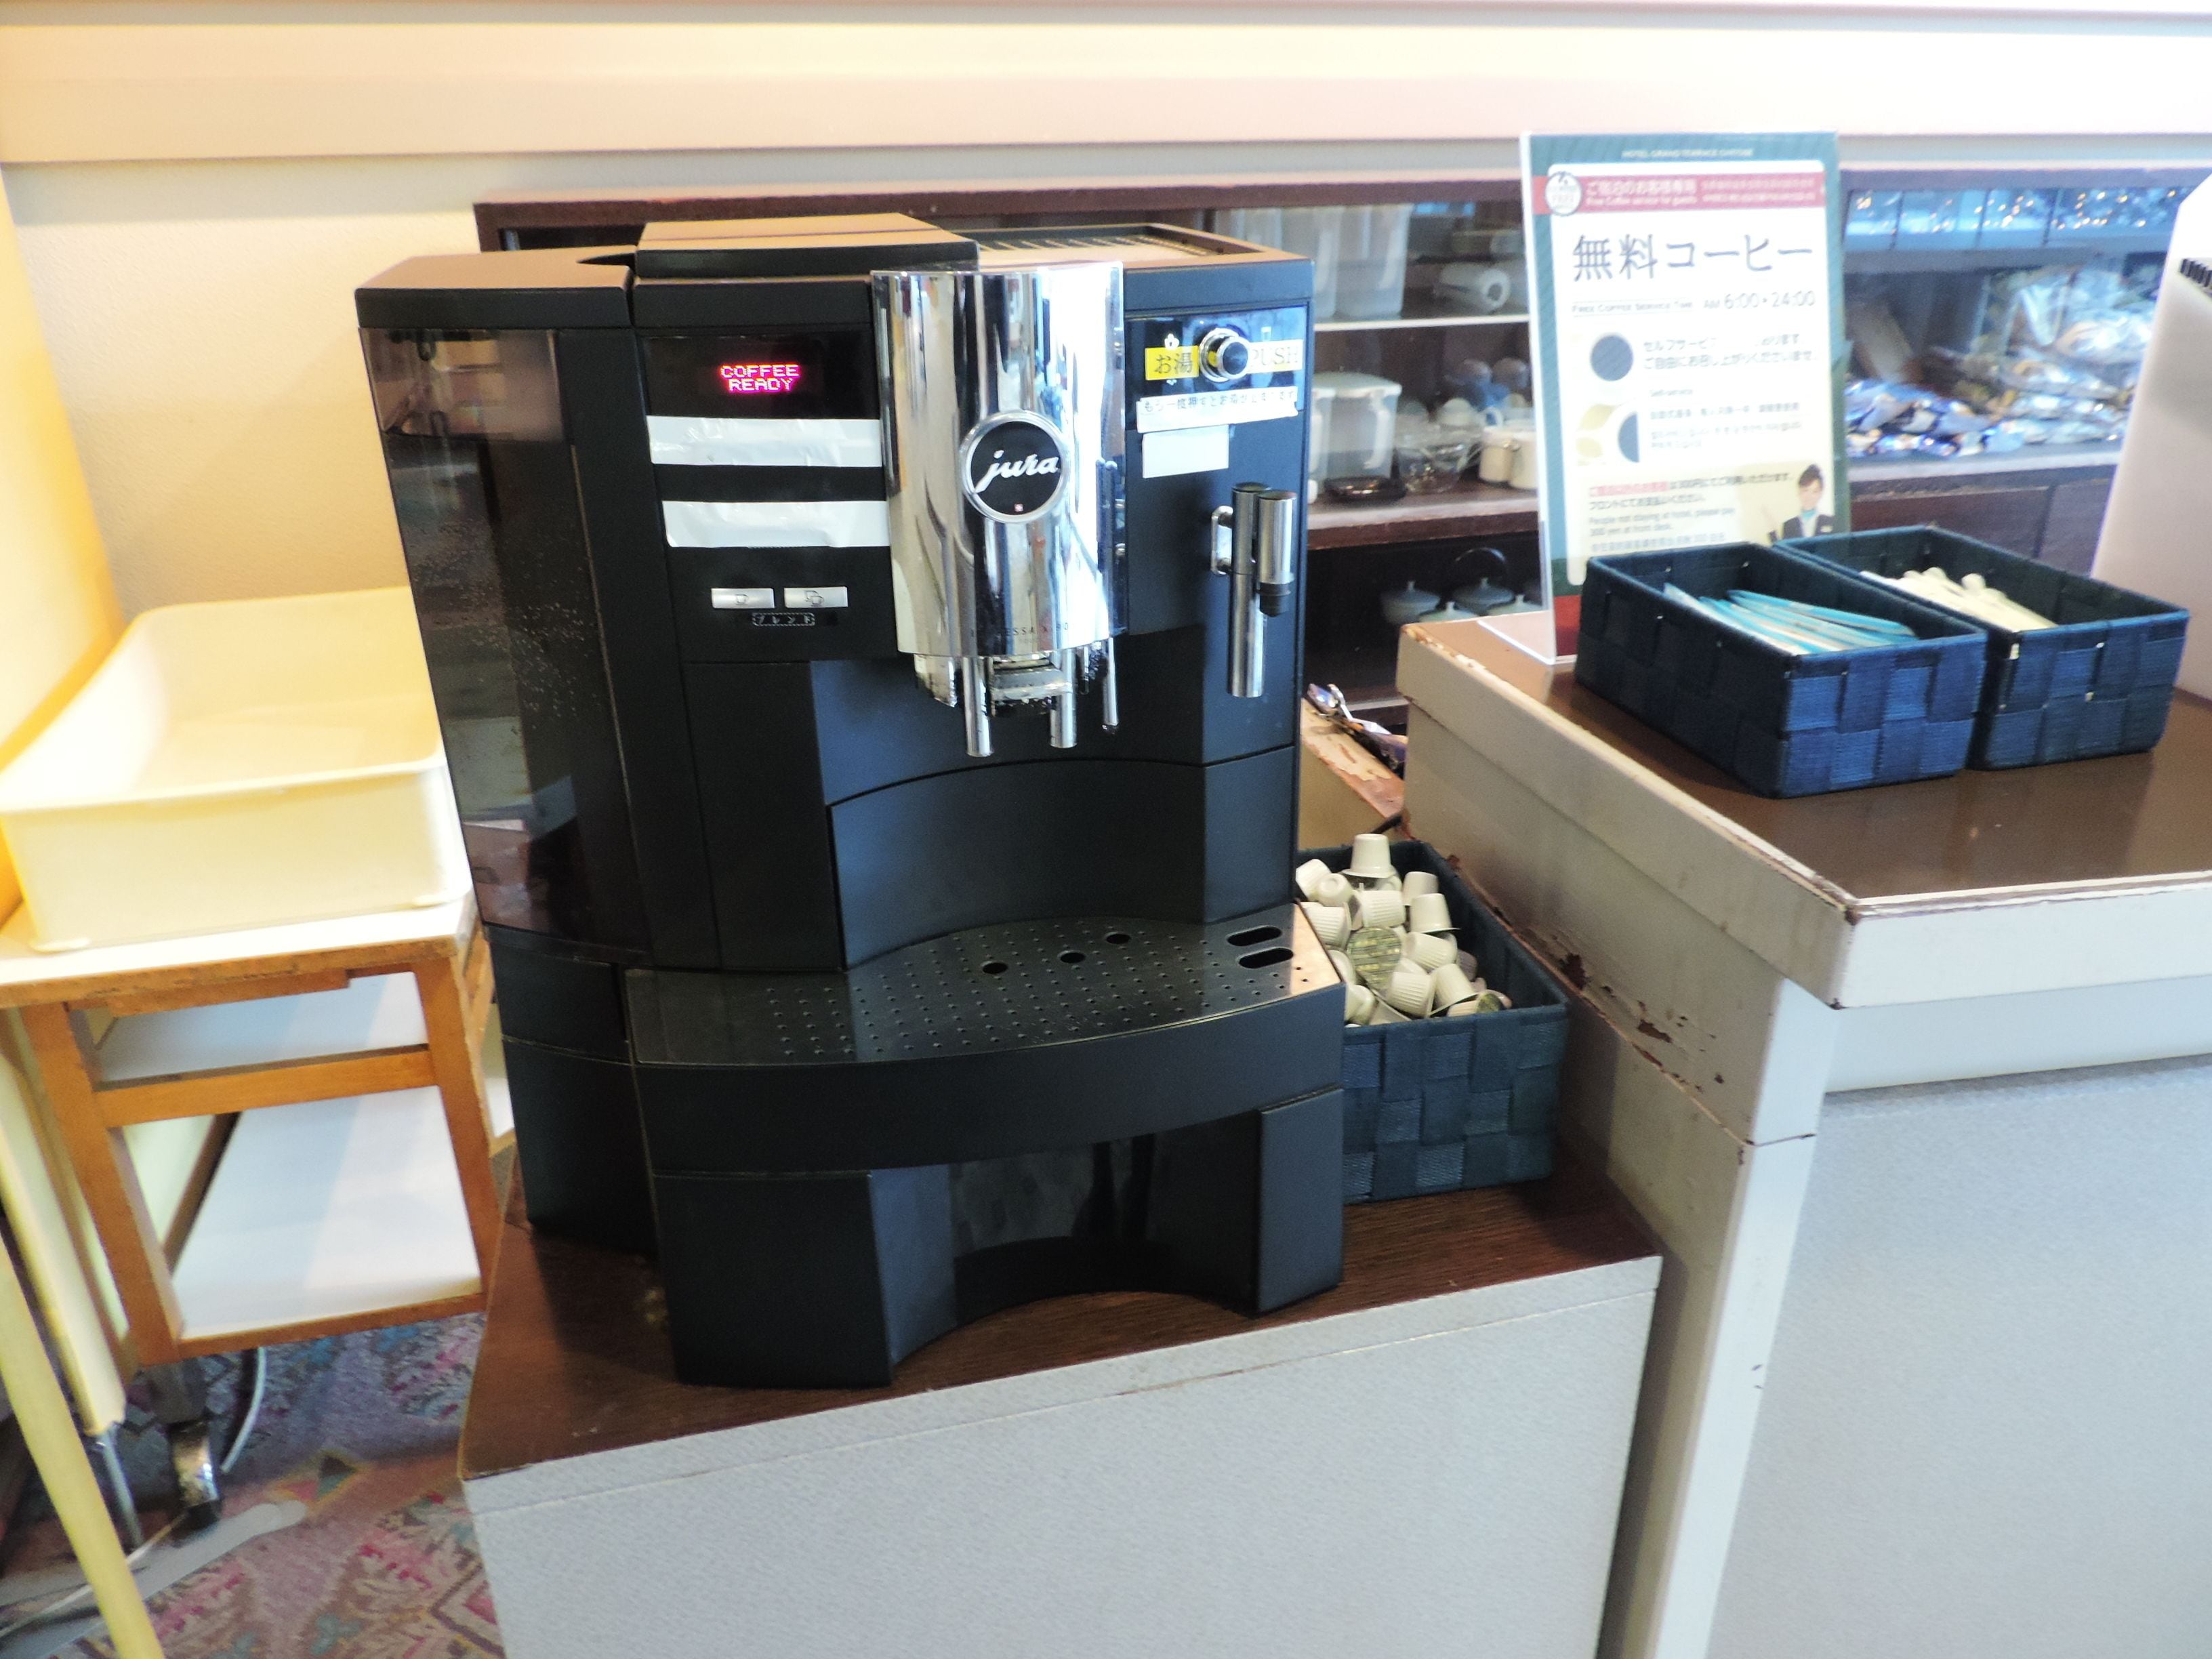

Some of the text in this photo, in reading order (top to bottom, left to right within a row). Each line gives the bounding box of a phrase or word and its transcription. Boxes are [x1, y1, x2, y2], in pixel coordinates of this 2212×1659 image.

[1572, 233, 1813, 282] 無料コーヒー
[1154, 352, 1193, 374] お湯
[1250, 346, 1299, 367] PUSH
[719, 363, 800, 379] COFFEE
[728, 377, 793, 392] READY
[975, 449, 1060, 494] jura
